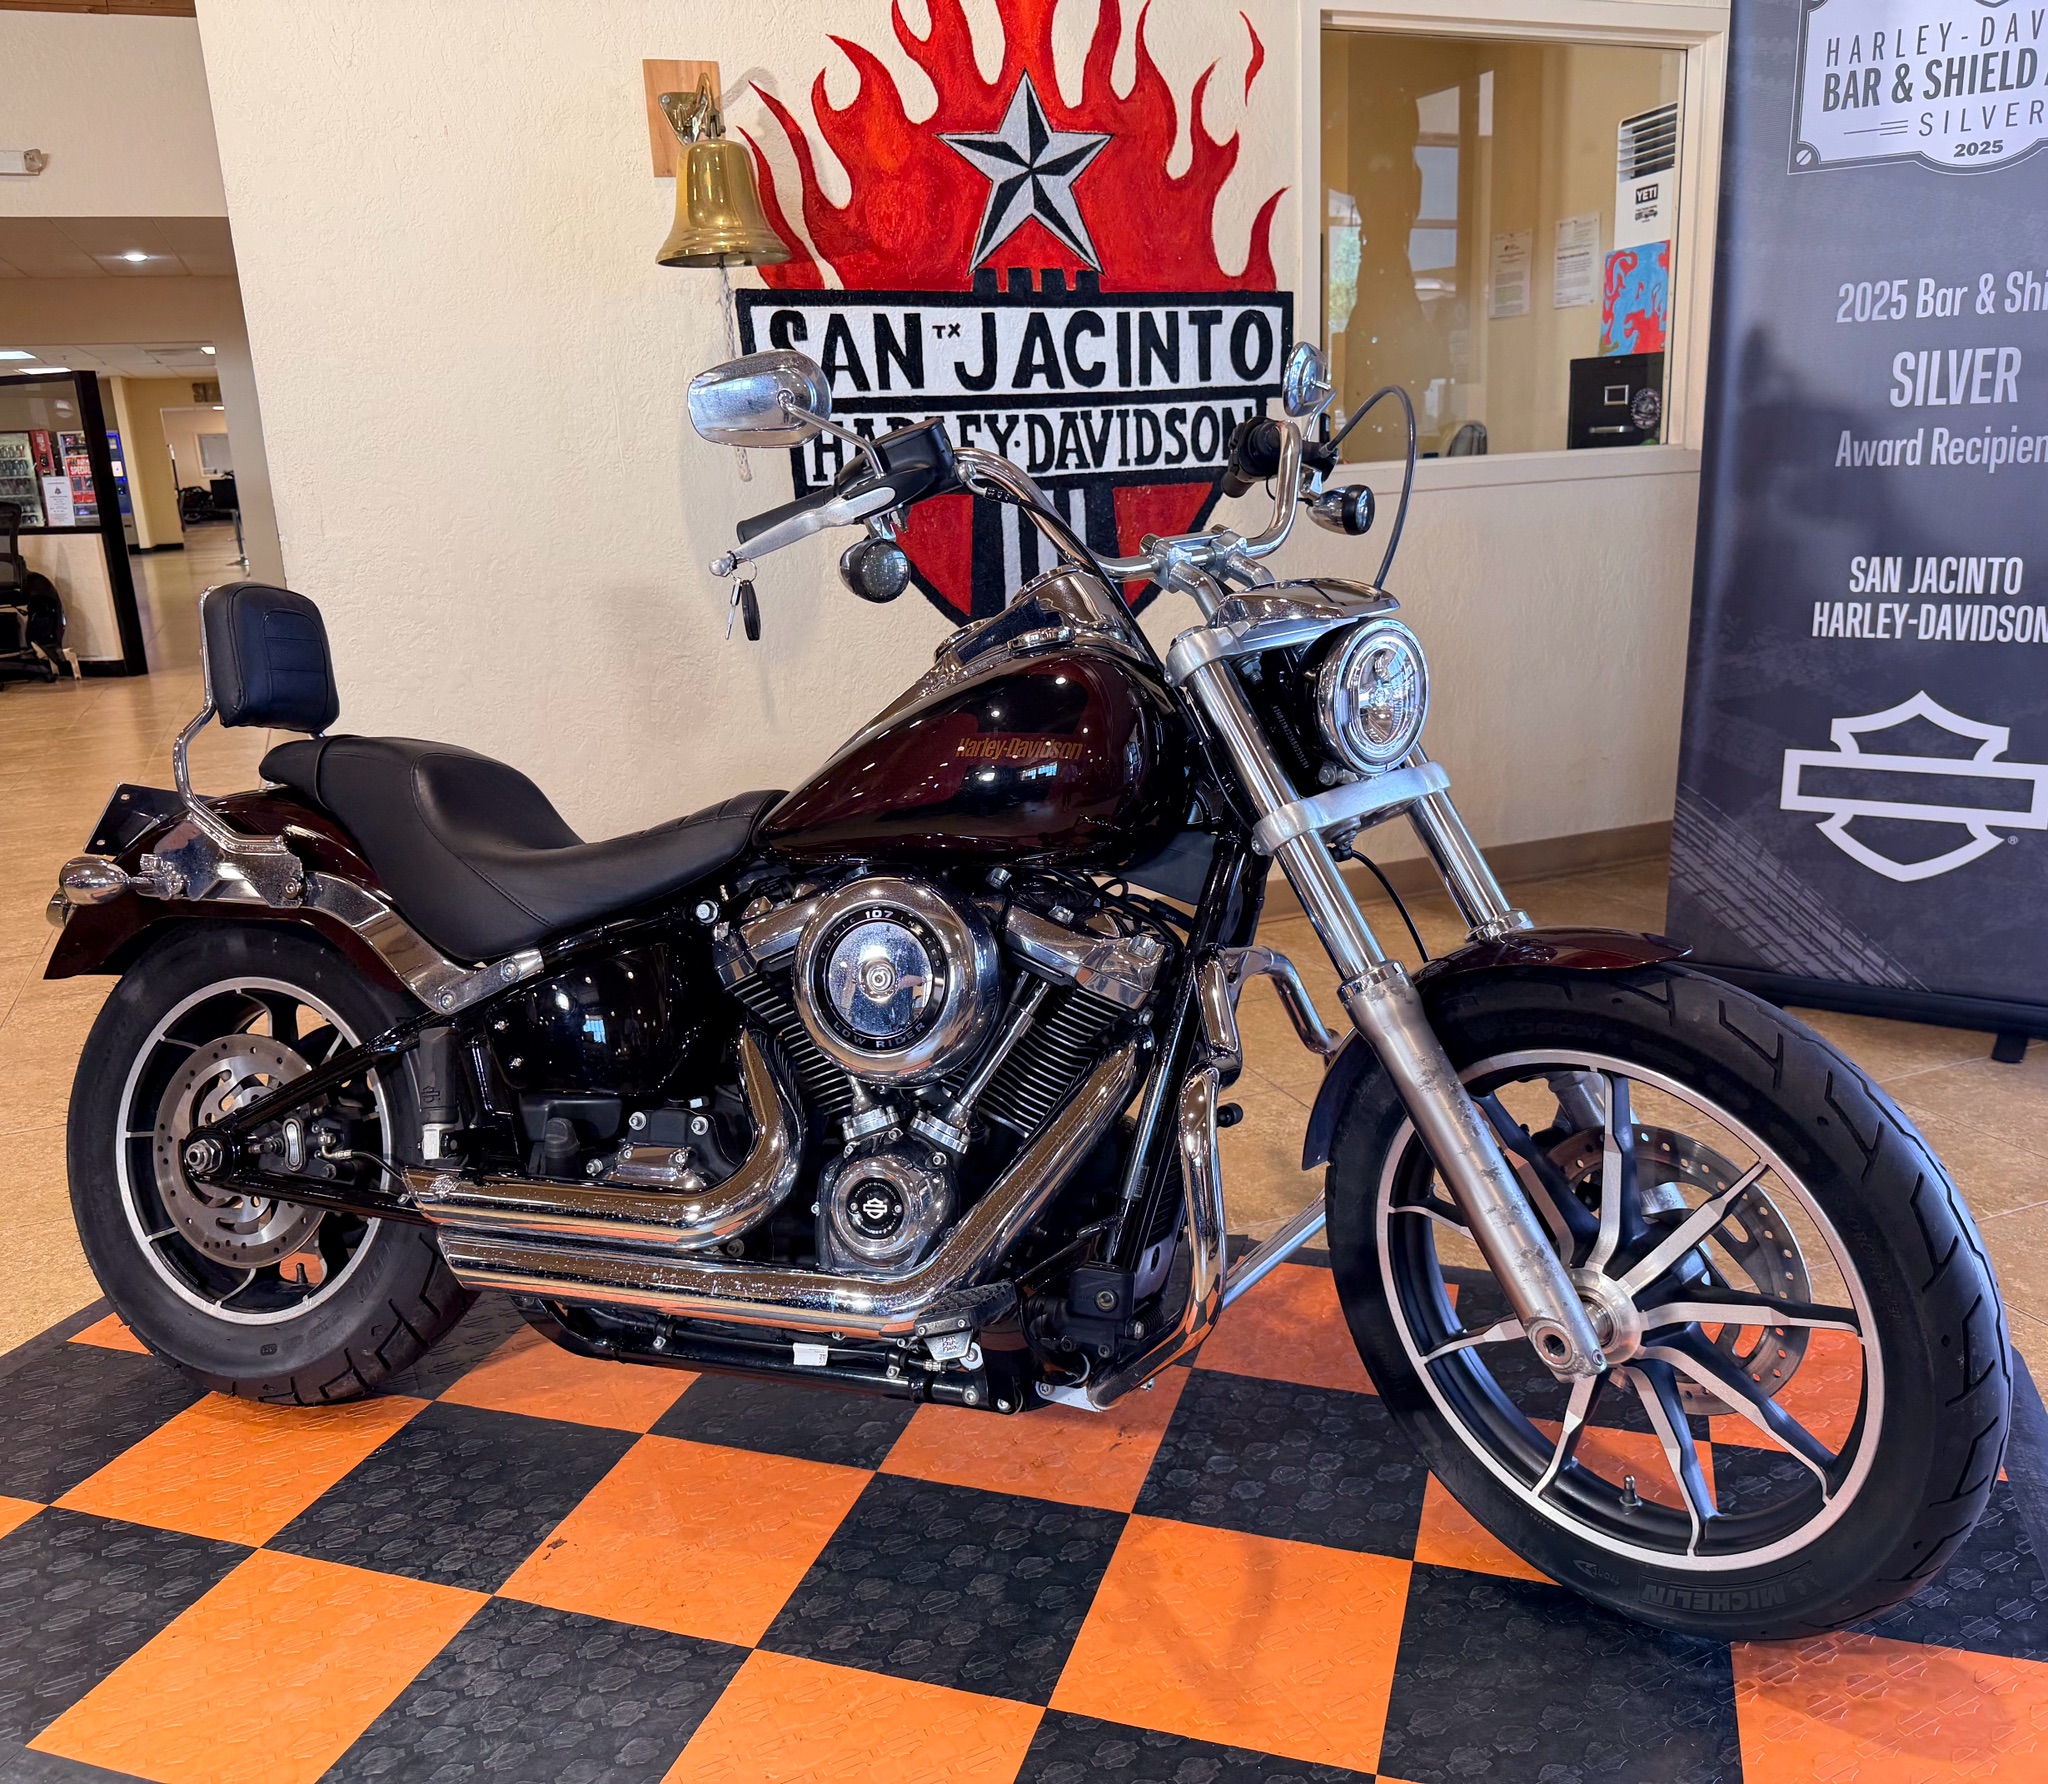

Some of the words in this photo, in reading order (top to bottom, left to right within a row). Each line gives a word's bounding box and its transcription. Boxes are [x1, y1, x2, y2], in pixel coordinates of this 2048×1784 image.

[1826, 8, 2046, 67] HARLEY-DAV
[1822, 67, 1882, 112] BAR
[1891, 63, 1913, 104] &
[1923, 47, 2038, 100] SHIELD
[1918, 99, 2044, 137] SILVER
[1953, 139, 2004, 158] 2025
[1636, 186, 1658, 202] YETI
[1836, 279, 1909, 323] 2025
[1915, 277, 1968, 319] Bar
[1974, 272, 1997, 316] &
[932, 322, 961, 340] TX
[953, 308, 1274, 392] JACINTO
[1889, 346, 2022, 408] SILVER
[1835, 427, 1924, 468] Award
[1930, 425, 2048, 474] Recipien
[1849, 555, 1903, 594] SAN
[1908, 556, 2024, 596] JACINTO
[1811, 600, 2048, 644] HARLEY-DAVIDSON
[955, 737, 1085, 760] Harley-Davidson
[865, 909, 894, 919] 107
[833, 1021, 866, 1045] LOW
[875, 1022, 926, 1049] RIDER
[1642, 1582, 1786, 1612] MICHELIN
